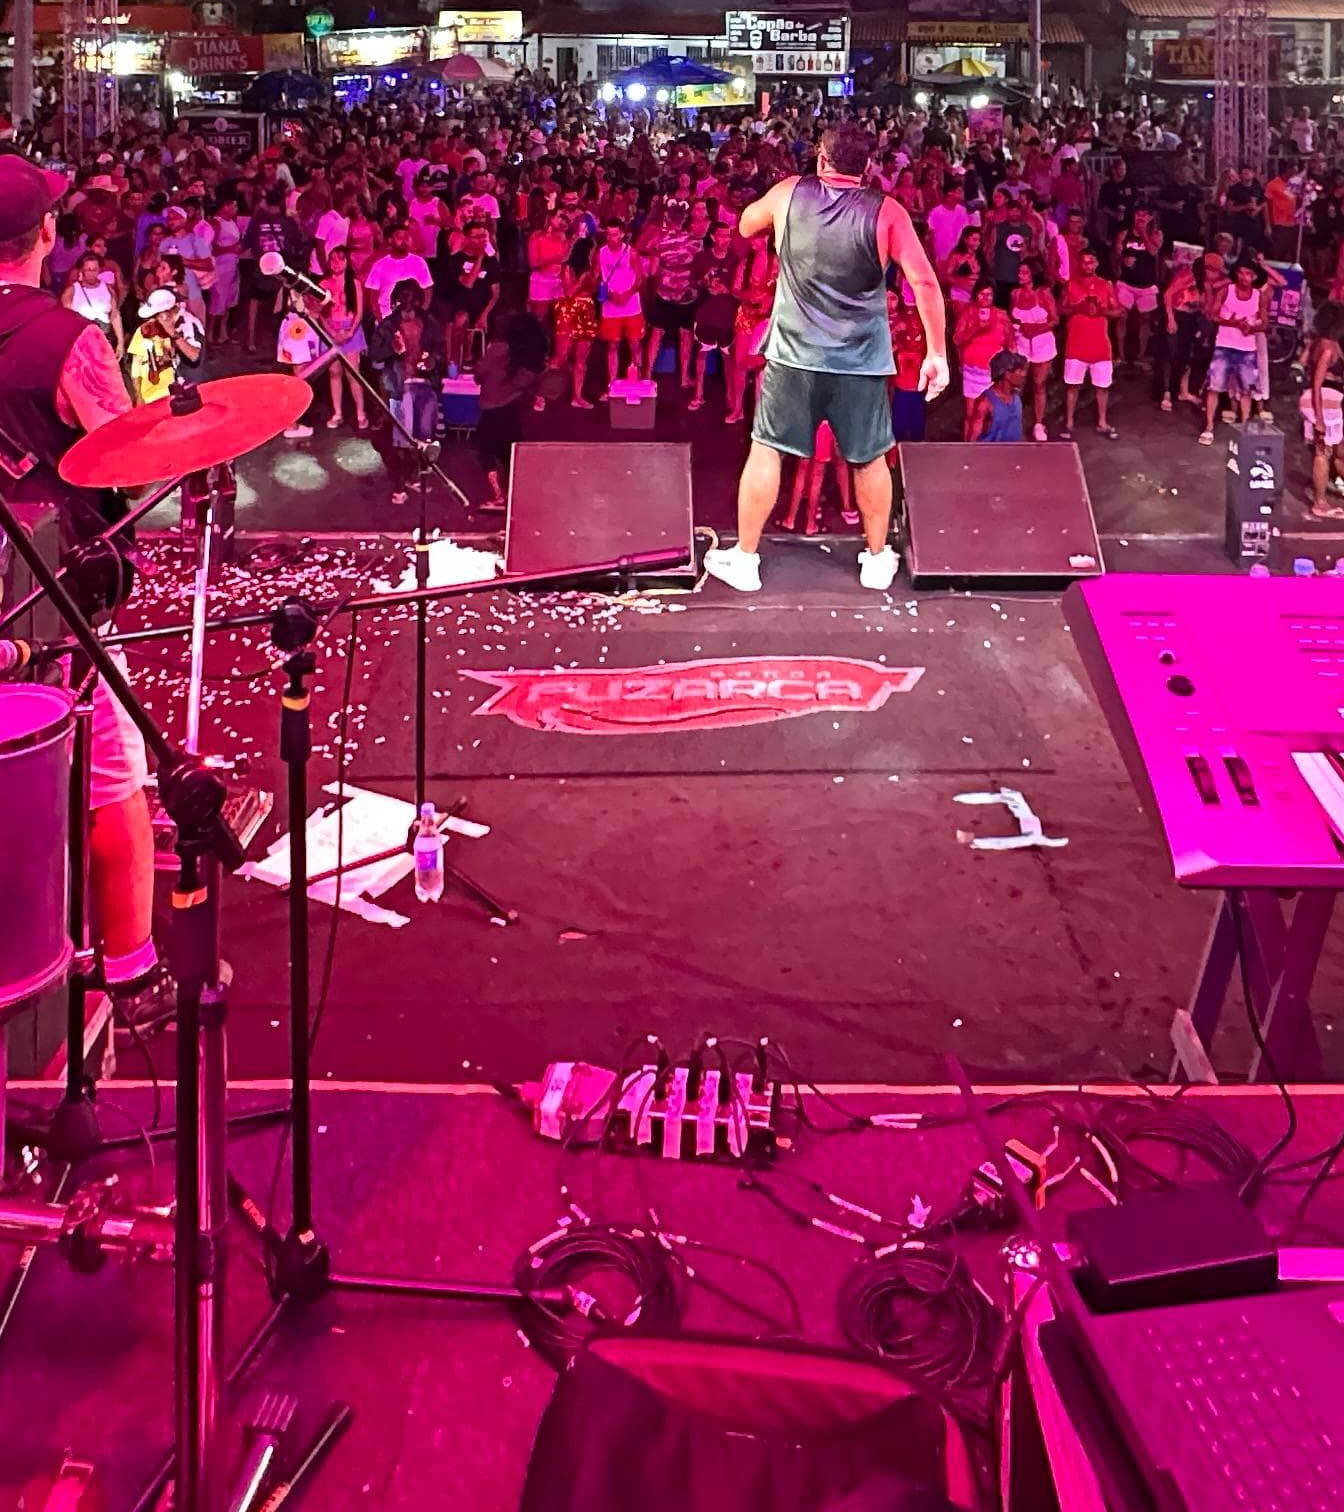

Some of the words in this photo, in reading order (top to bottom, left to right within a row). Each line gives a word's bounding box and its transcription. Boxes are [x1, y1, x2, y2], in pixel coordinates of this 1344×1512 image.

[770, 29, 817, 42] Barba
[194, 39, 241, 54] TIANA
[188, 54, 248, 71] DRINK'S
[526, 678, 863, 701] FUZARCA
